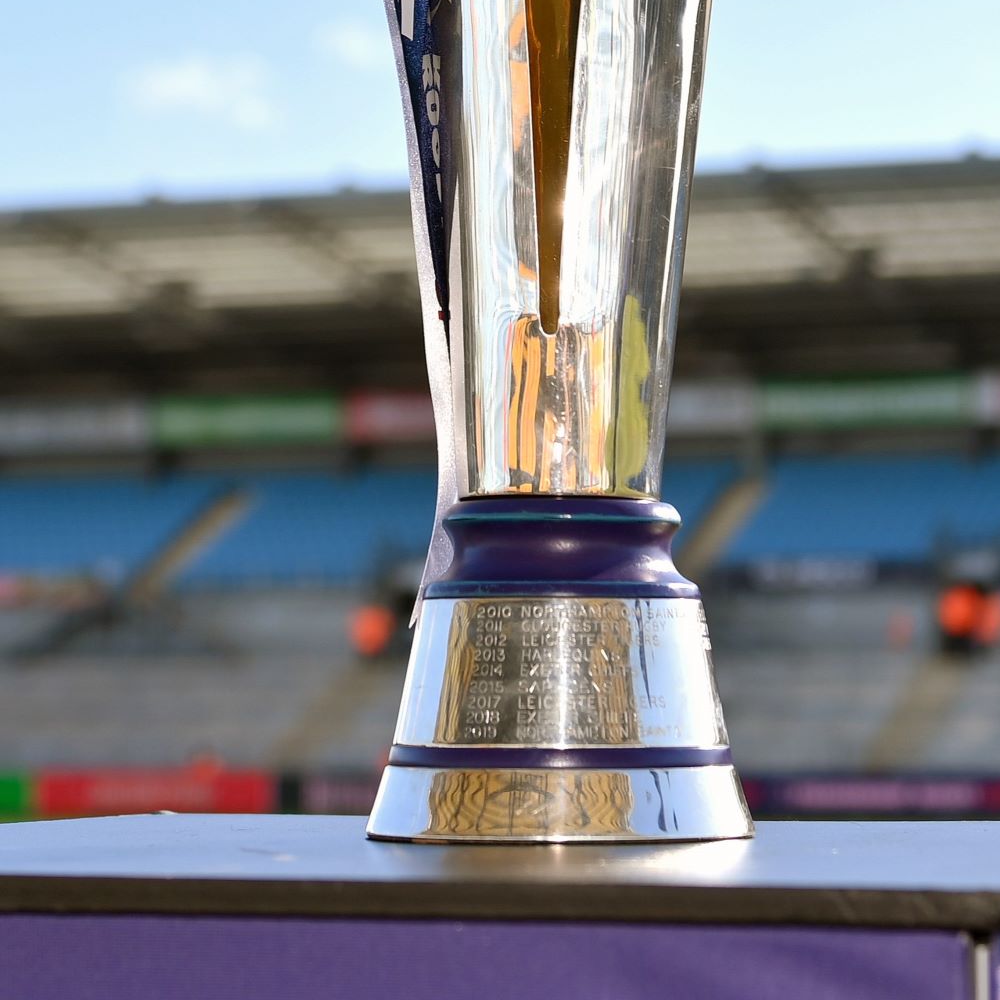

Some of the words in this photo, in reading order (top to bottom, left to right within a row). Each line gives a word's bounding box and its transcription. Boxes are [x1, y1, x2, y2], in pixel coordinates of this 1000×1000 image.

[476, 606, 512, 619] 2010
[476, 620, 504, 633] 2011
[475, 634, 507, 647] 2012
[521, 634, 605, 648] LEICSTER
[473, 649, 506, 662] 2013
[472, 664, 504, 677] 2014
[519, 664, 581, 678] EXETR
[470, 680, 504, 693] 2015
[467, 696, 500, 709] 2017
[518, 695, 607, 709] LEICSTER
[465, 710, 501, 724] 2018
[463, 726, 498, 739] 2019
